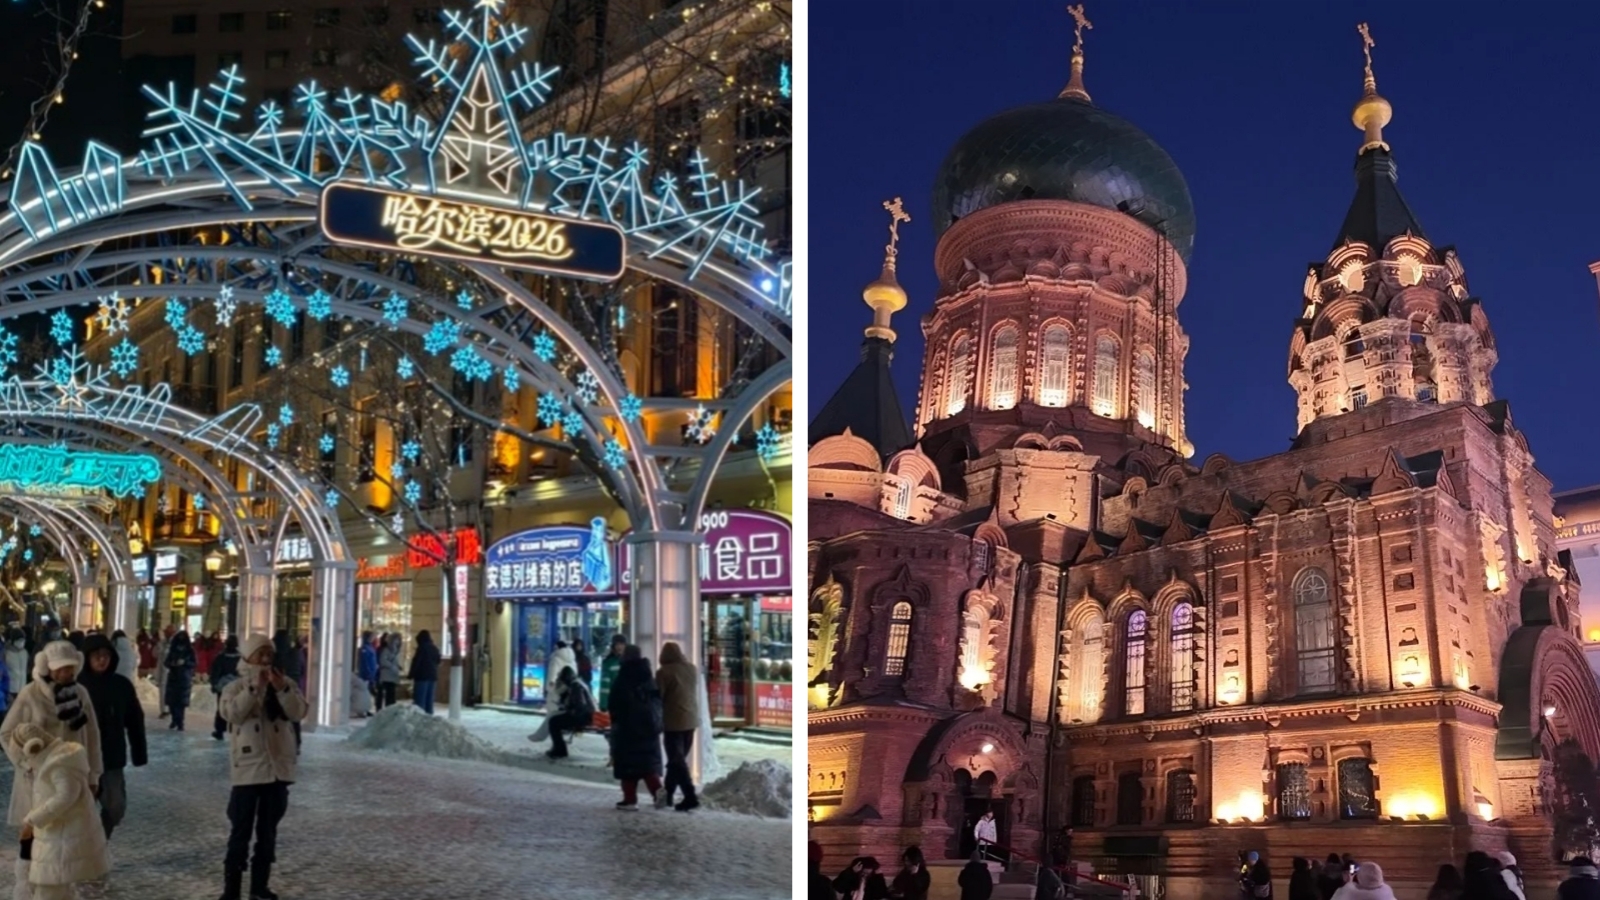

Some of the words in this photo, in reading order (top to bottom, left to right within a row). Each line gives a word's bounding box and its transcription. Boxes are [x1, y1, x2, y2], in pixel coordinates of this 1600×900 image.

[381, 195, 571, 258] 哈尔滨2026
[486, 560, 581, 588] 安德列维奇的店
